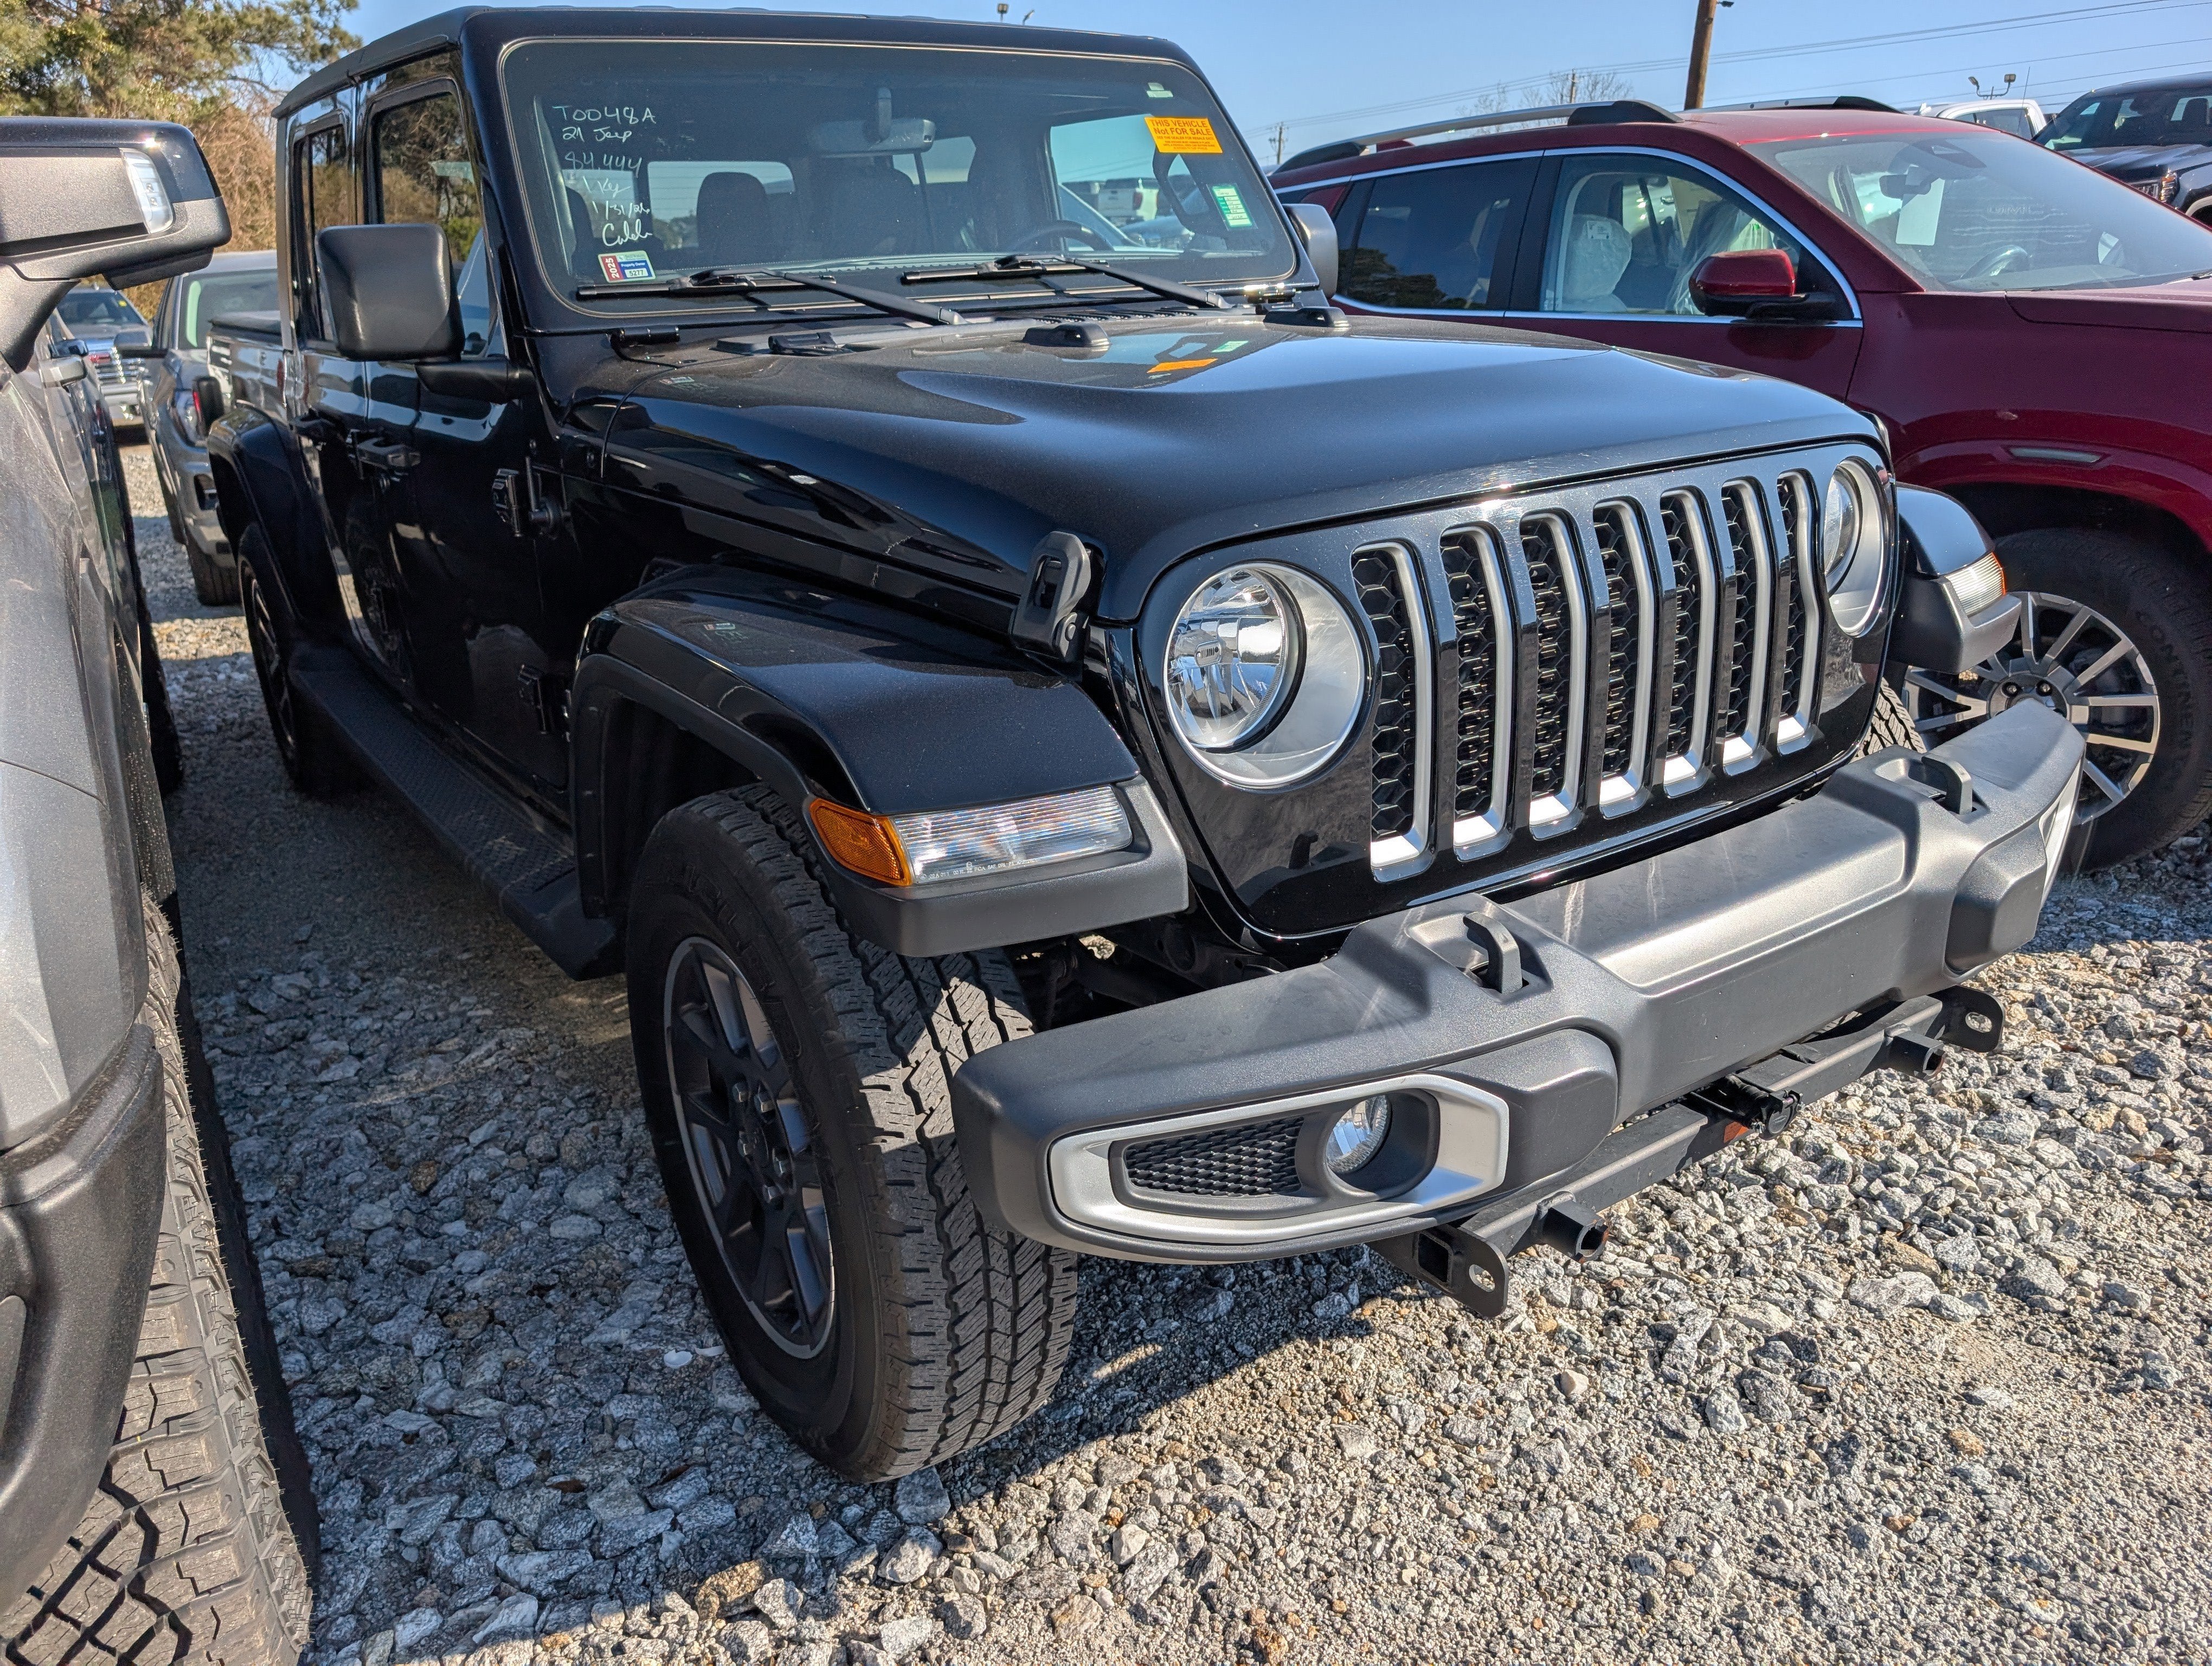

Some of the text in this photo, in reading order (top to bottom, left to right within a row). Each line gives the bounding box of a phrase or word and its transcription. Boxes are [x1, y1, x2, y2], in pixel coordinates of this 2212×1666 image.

[1171, 119, 1208, 127] VEHICLE
[562, 126, 632, 143] 21 Jeep
[605, 258, 620, 279] 2025
